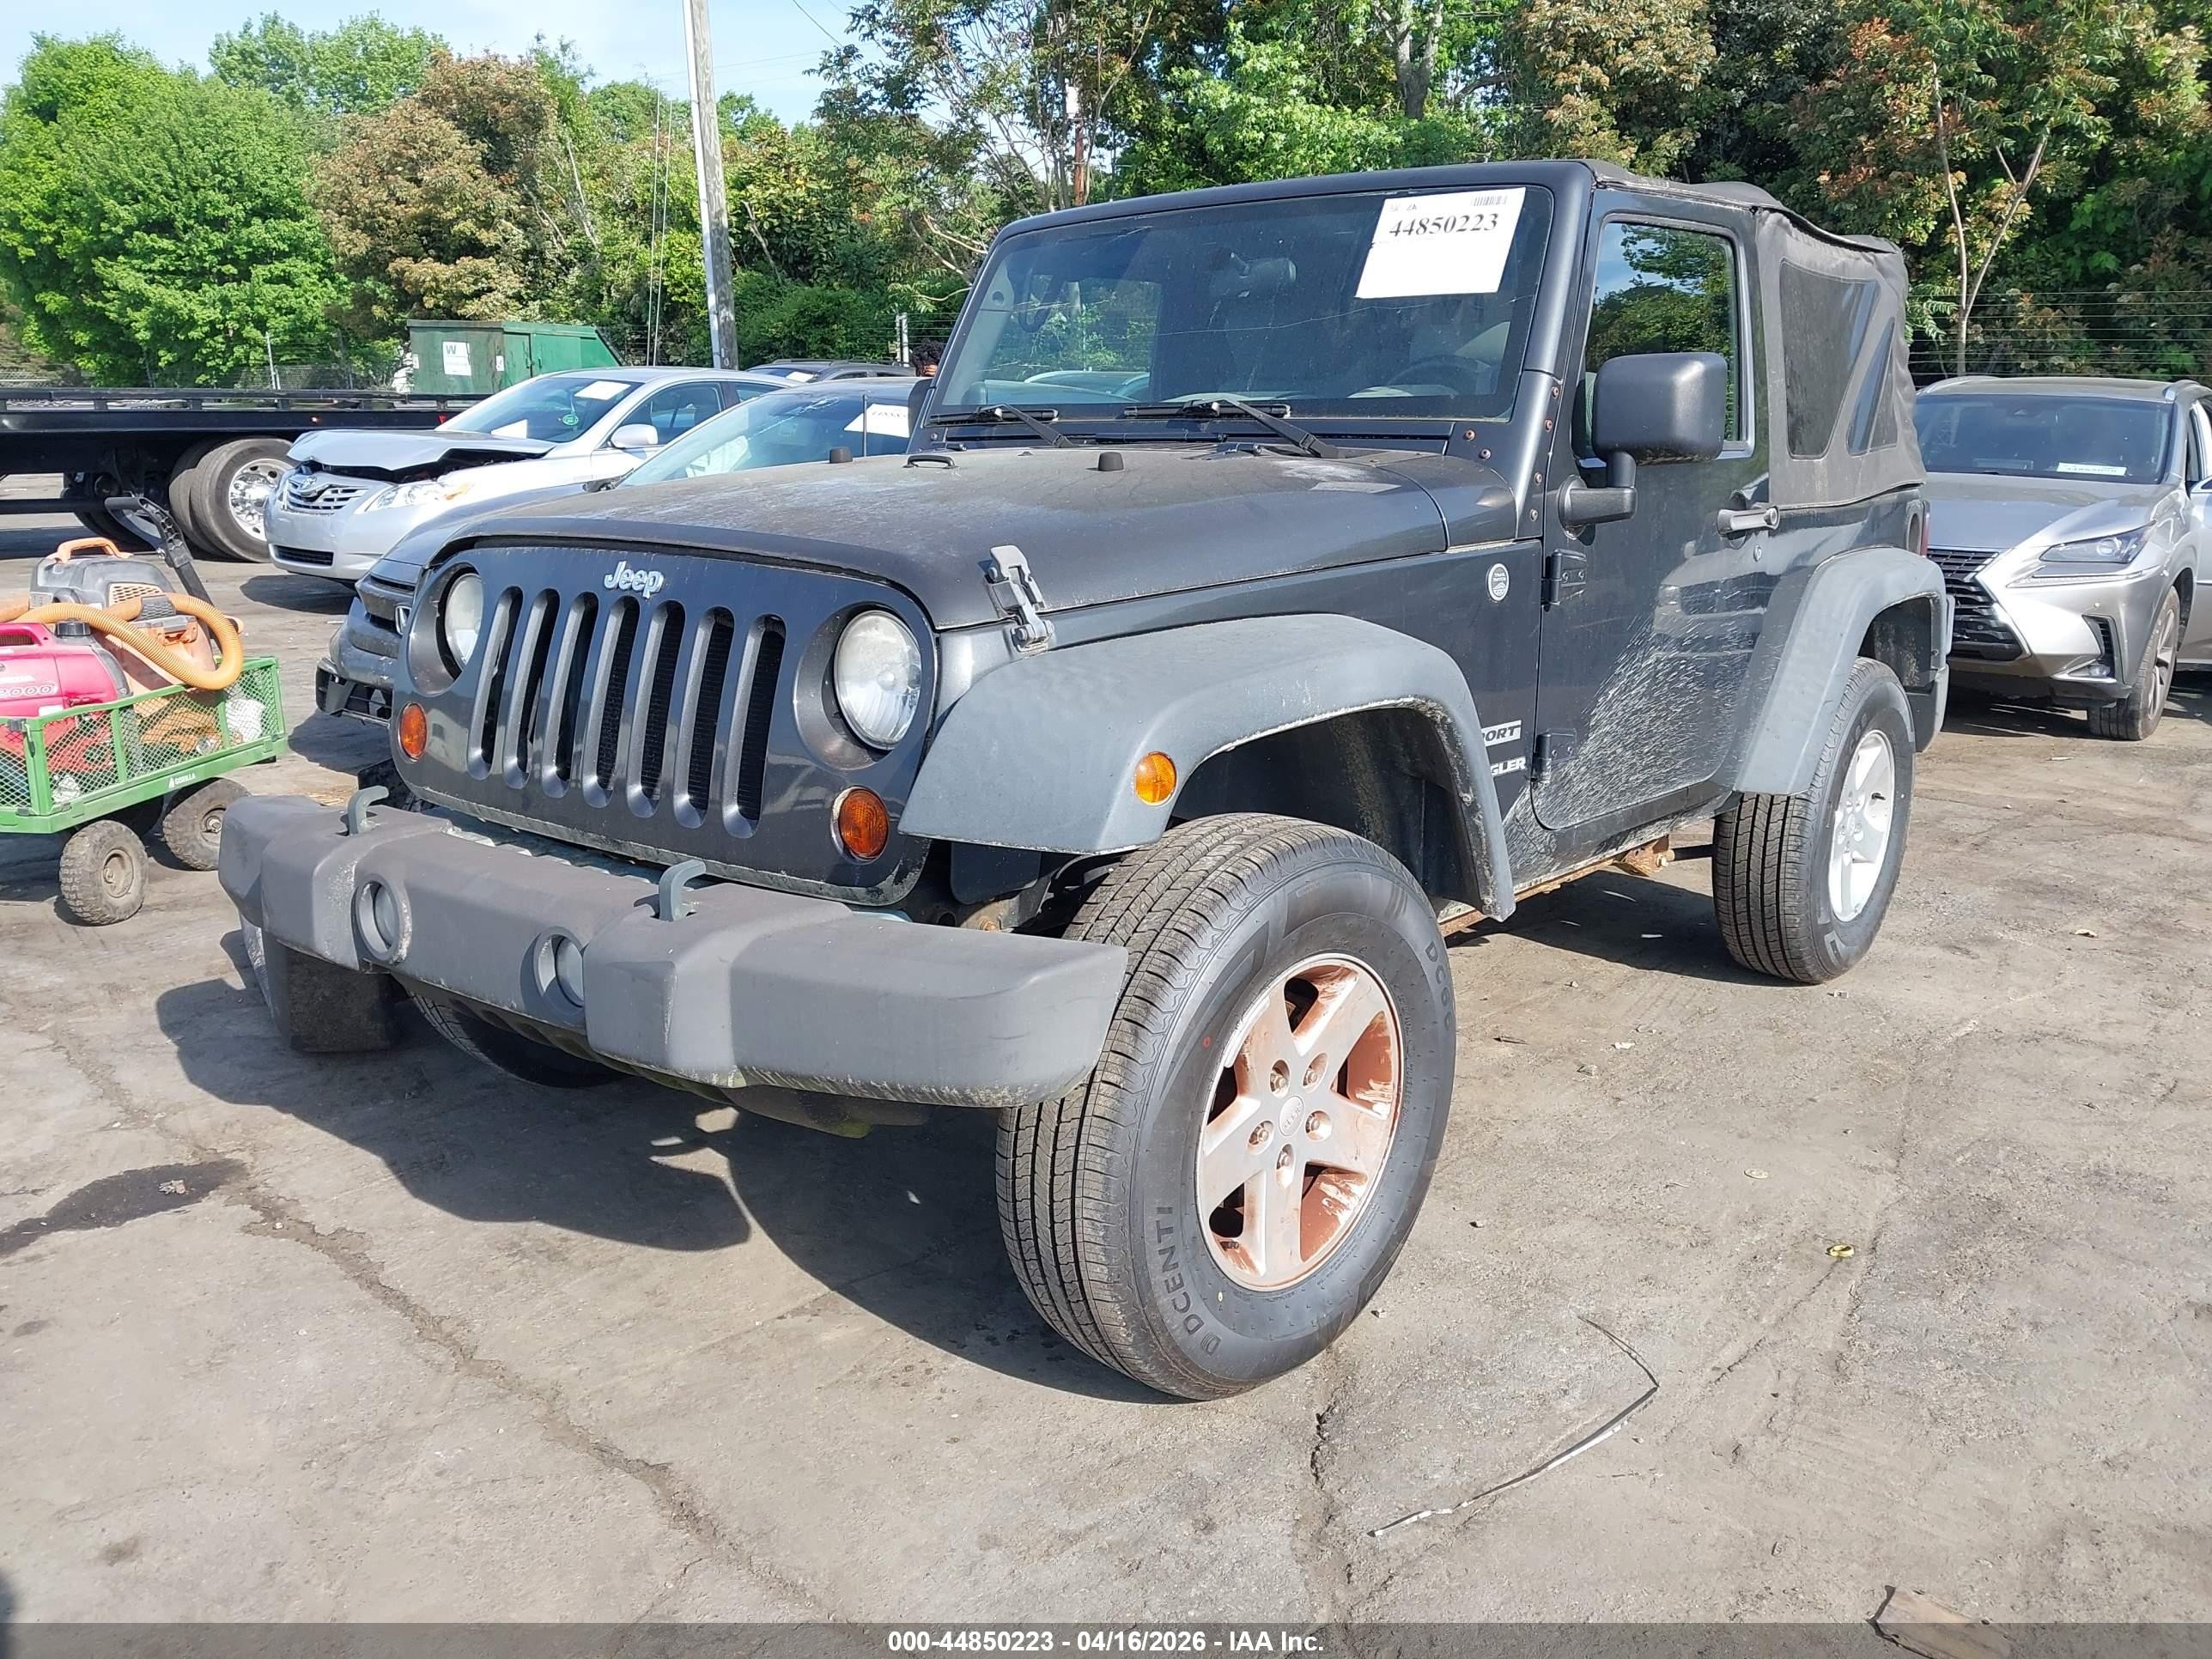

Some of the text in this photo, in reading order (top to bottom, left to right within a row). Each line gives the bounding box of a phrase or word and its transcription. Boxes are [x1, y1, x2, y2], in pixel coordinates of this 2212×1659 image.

[1389, 212, 1499, 237] 44850223
[604, 561, 665, 599] Jeep
[1482, 725, 1522, 742] ORT
